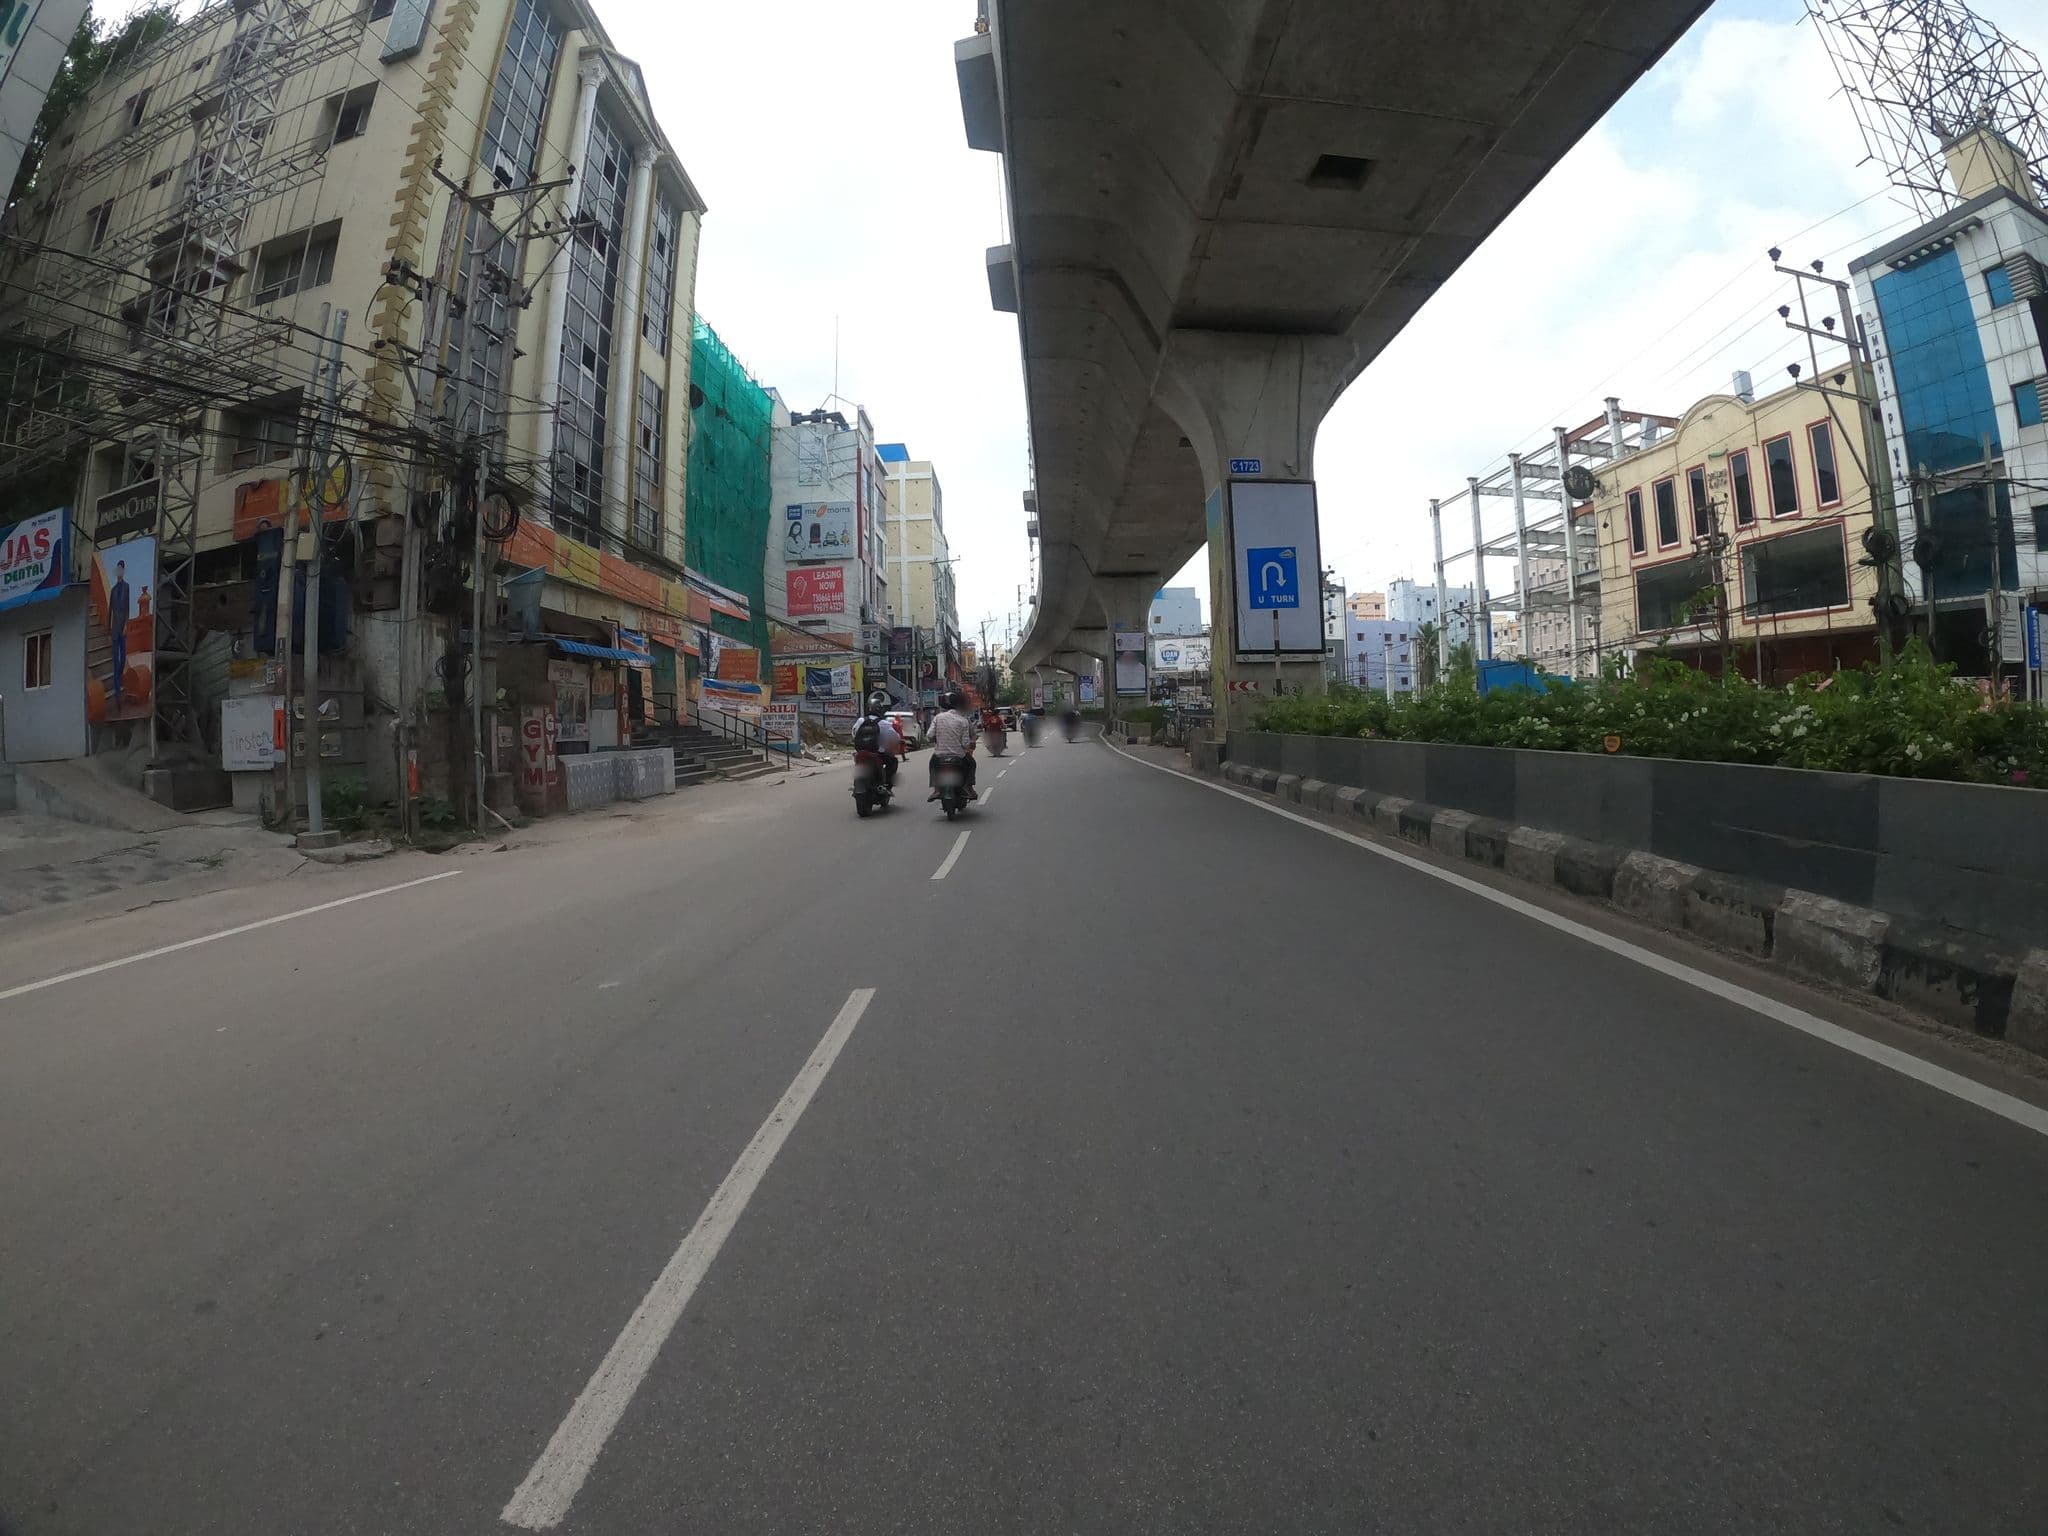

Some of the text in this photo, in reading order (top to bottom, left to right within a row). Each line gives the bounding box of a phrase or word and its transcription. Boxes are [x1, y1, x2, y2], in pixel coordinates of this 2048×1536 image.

[1231, 461, 1259, 472] C 1723
[4, 563, 44, 585] DENTAL
[813, 570, 842, 581] LEASING
[819, 581, 836, 590] NOW
[1258, 595, 1295, 604] U TURN
[1163, 650, 1178, 658] LOAN
[763, 704, 797, 713] SRILU
[523, 719, 543, 786] GYM
